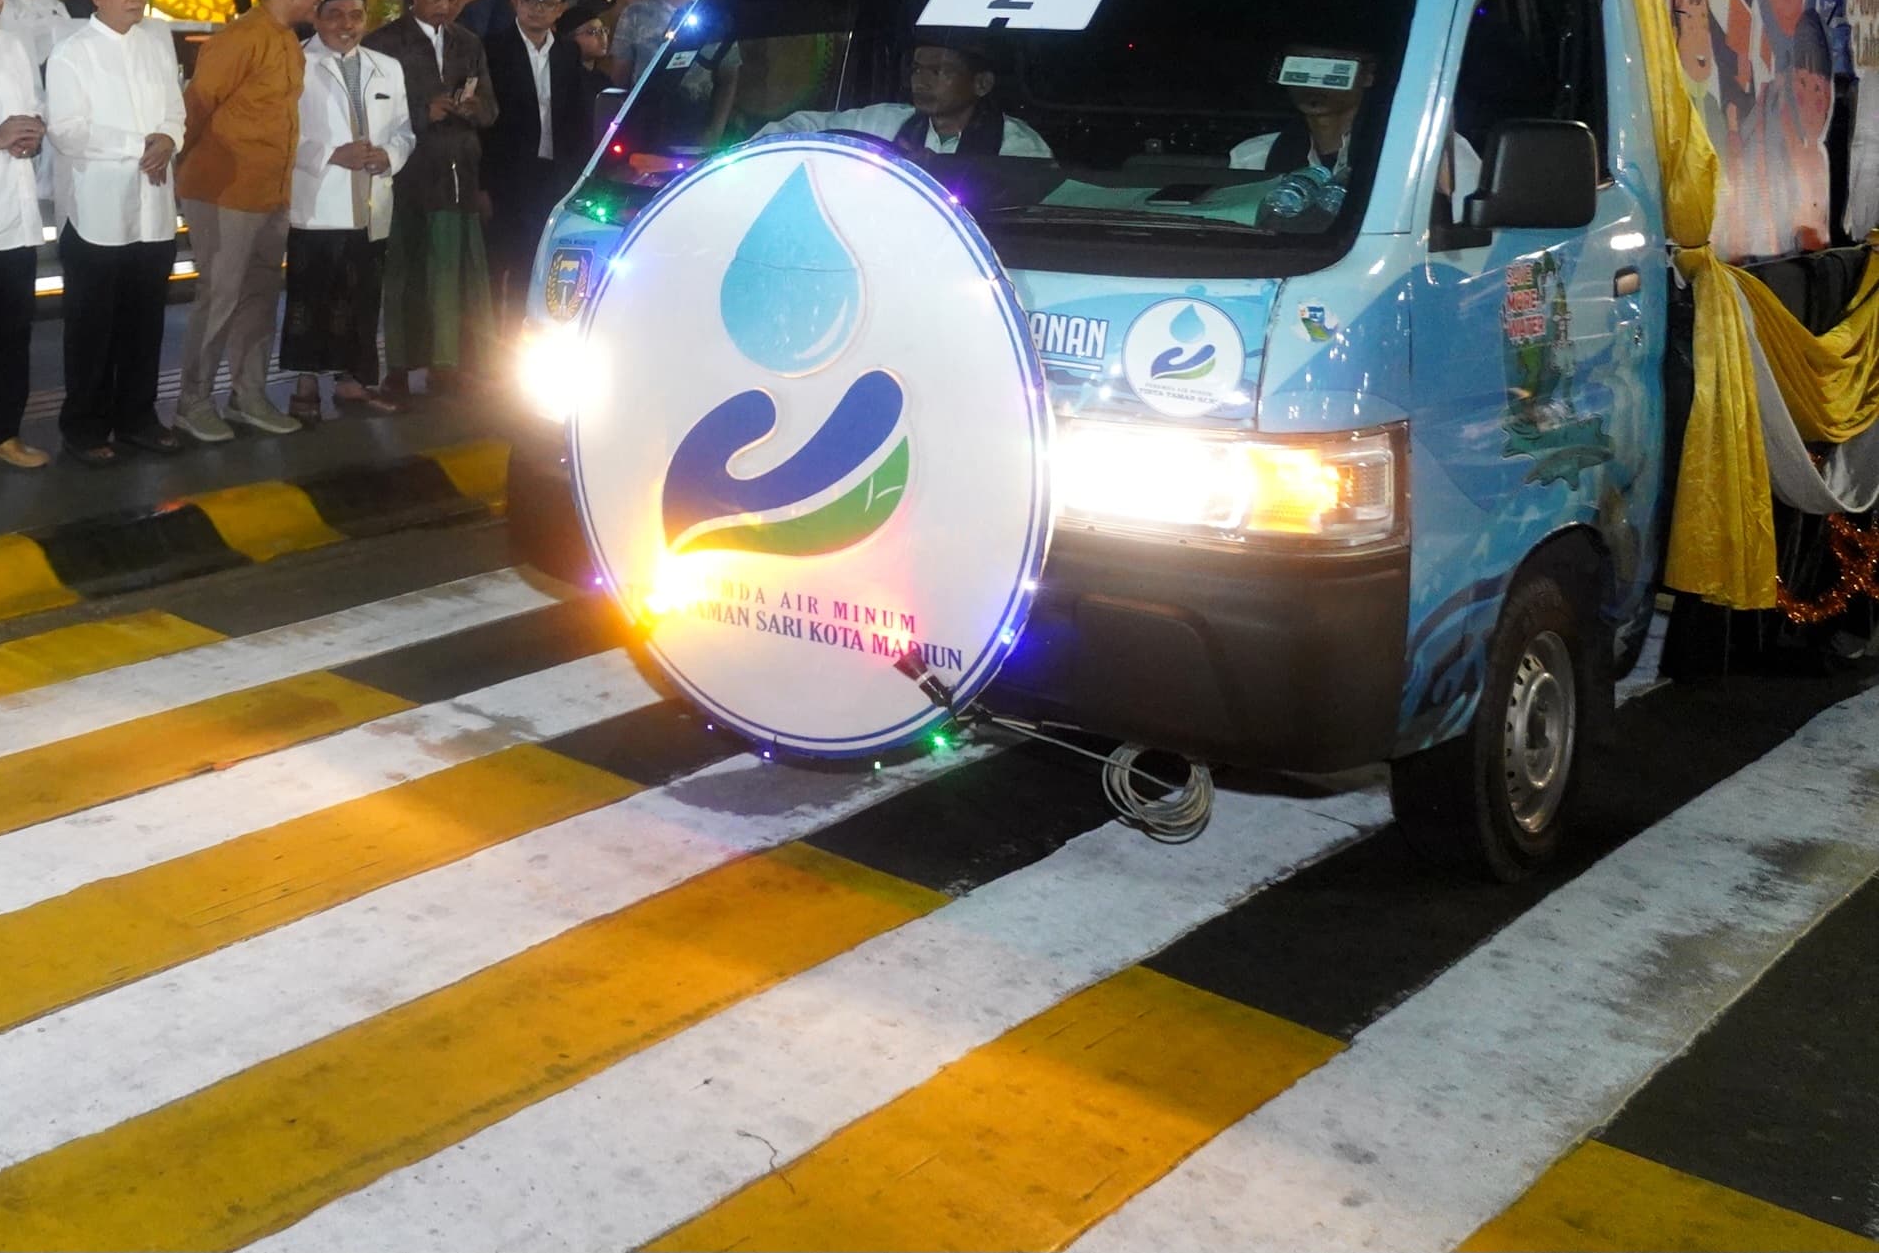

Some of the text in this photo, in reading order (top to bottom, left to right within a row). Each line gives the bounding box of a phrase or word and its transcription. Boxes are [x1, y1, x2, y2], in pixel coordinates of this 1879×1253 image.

[1507, 288, 1538, 312] MORE
[1025, 311, 1109, 360] ANAN
[1508, 314, 1546, 339] WATER
[691, 599, 750, 629] AMAN
[756, 609, 803, 639] SARI
[809, 621, 864, 652] KOTA
[780, 591, 819, 615] AIR
[833, 600, 916, 634] MINUM
